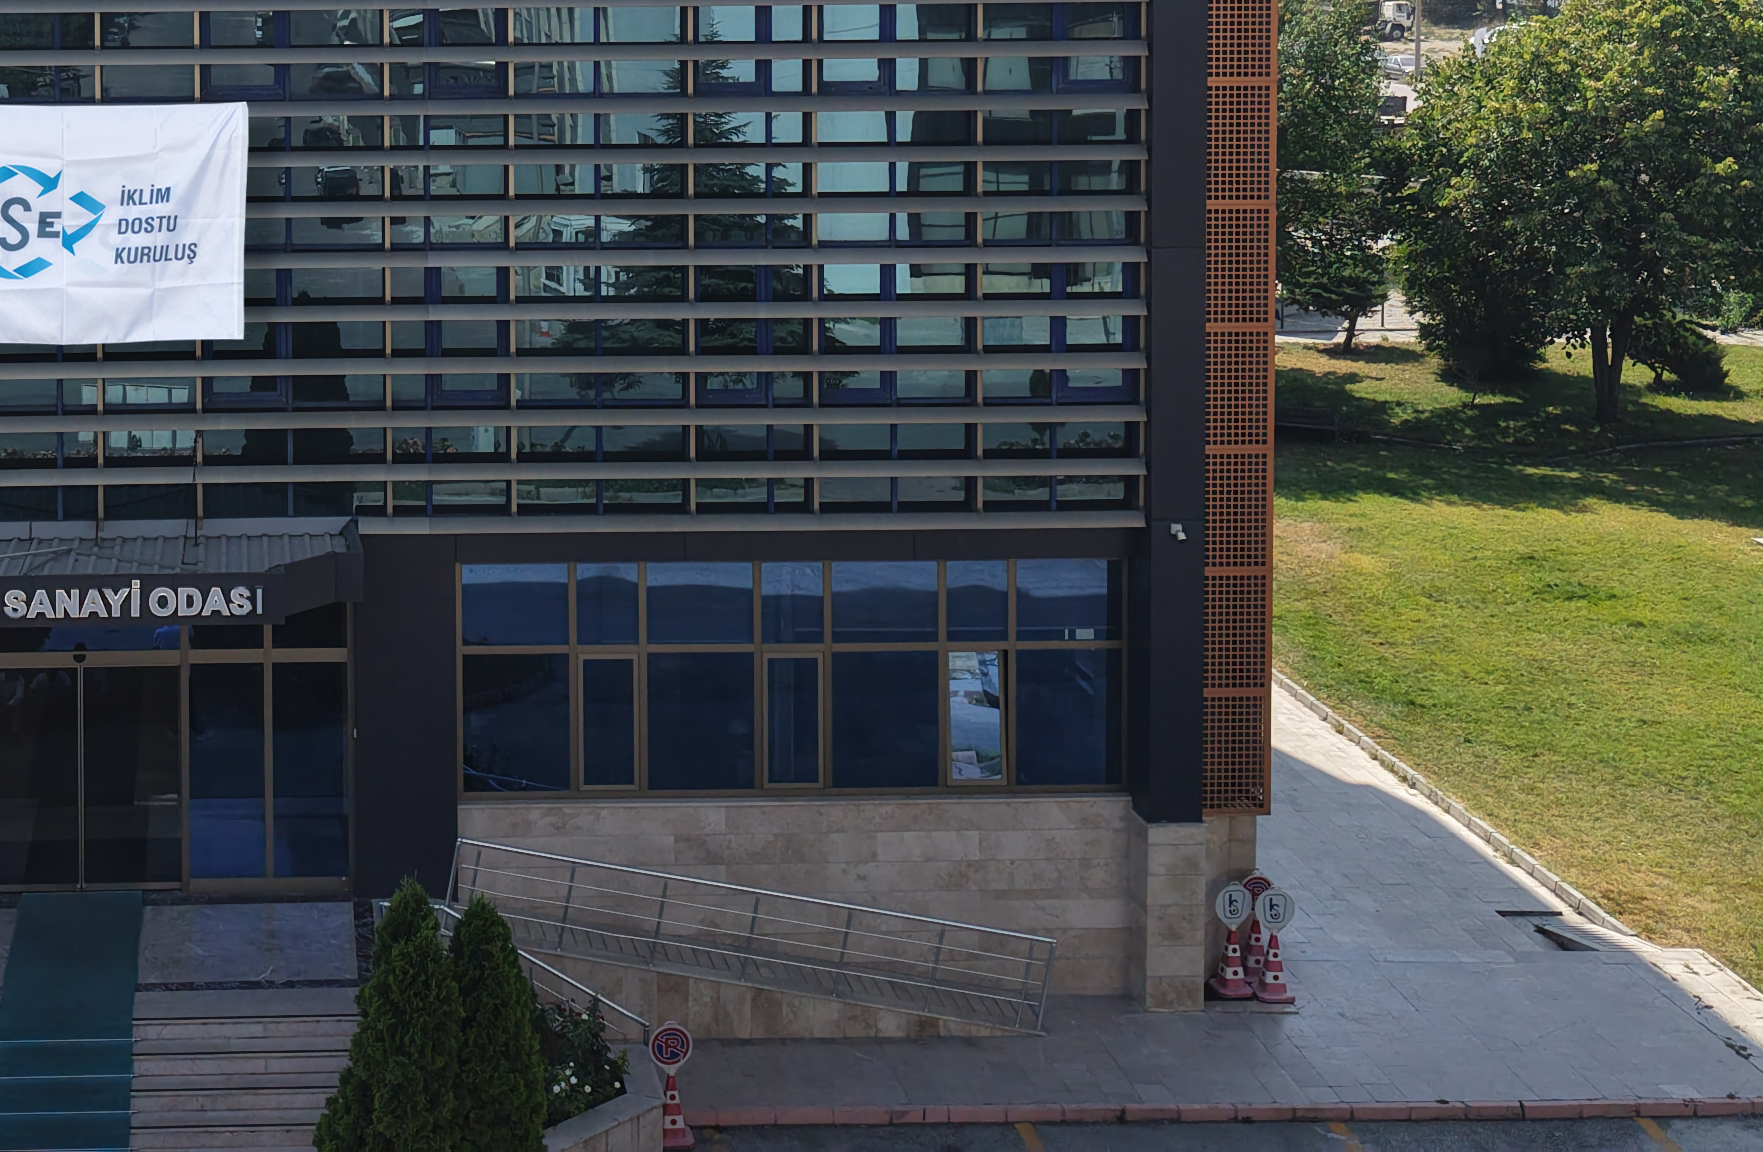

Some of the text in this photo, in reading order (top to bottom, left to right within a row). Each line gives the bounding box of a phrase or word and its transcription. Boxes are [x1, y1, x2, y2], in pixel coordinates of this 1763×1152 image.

[119, 184, 172, 207] İKLİM
[117, 215, 178, 235] DOSTU
[113, 242, 198, 266] KURULUŞ
[3, 579, 141, 620] SANAYİ
[148, 585, 263, 618] ODASI
